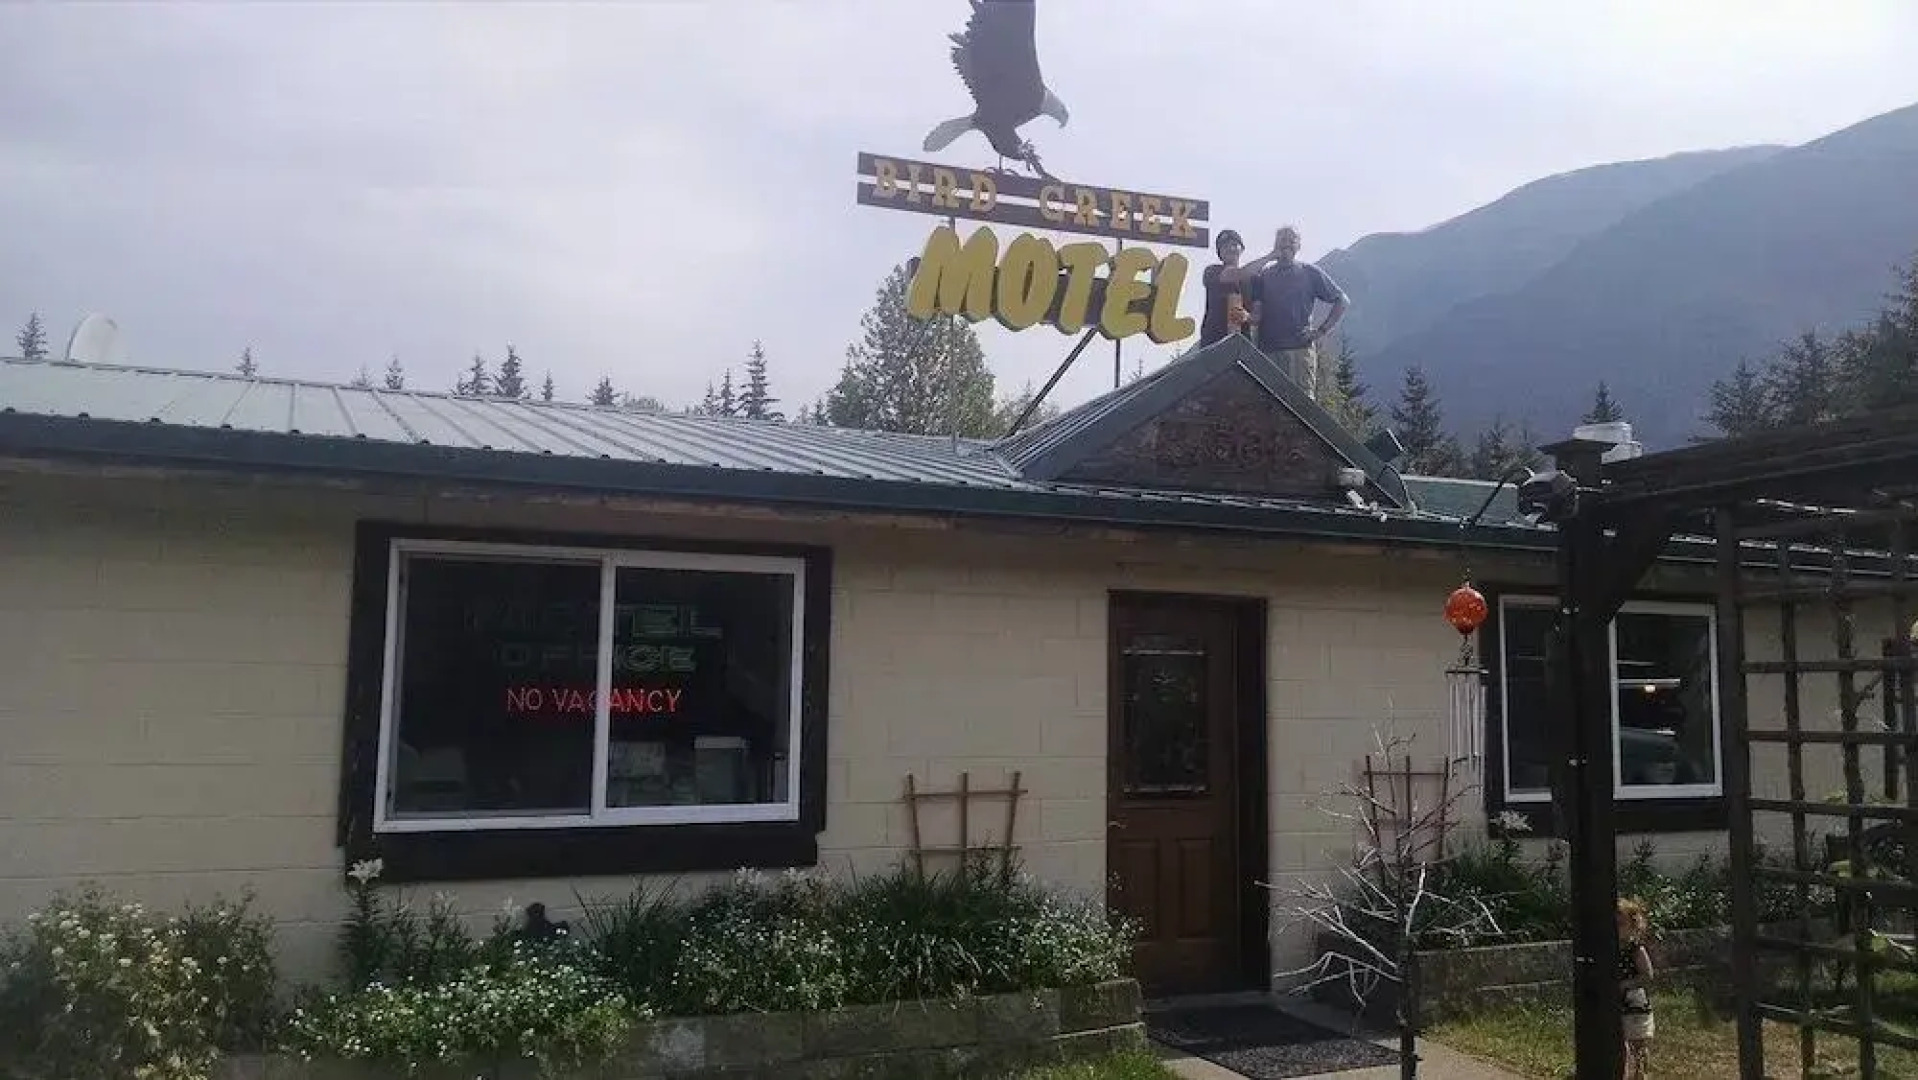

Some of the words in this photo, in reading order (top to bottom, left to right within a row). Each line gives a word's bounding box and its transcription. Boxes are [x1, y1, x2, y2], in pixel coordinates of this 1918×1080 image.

[873, 158, 997, 213] BIRD
[1039, 182, 1198, 239] CREEK
[908, 225, 1196, 344] MOTEL
[506, 686, 543, 713] NO
[551, 687, 682, 713] VACANCY
